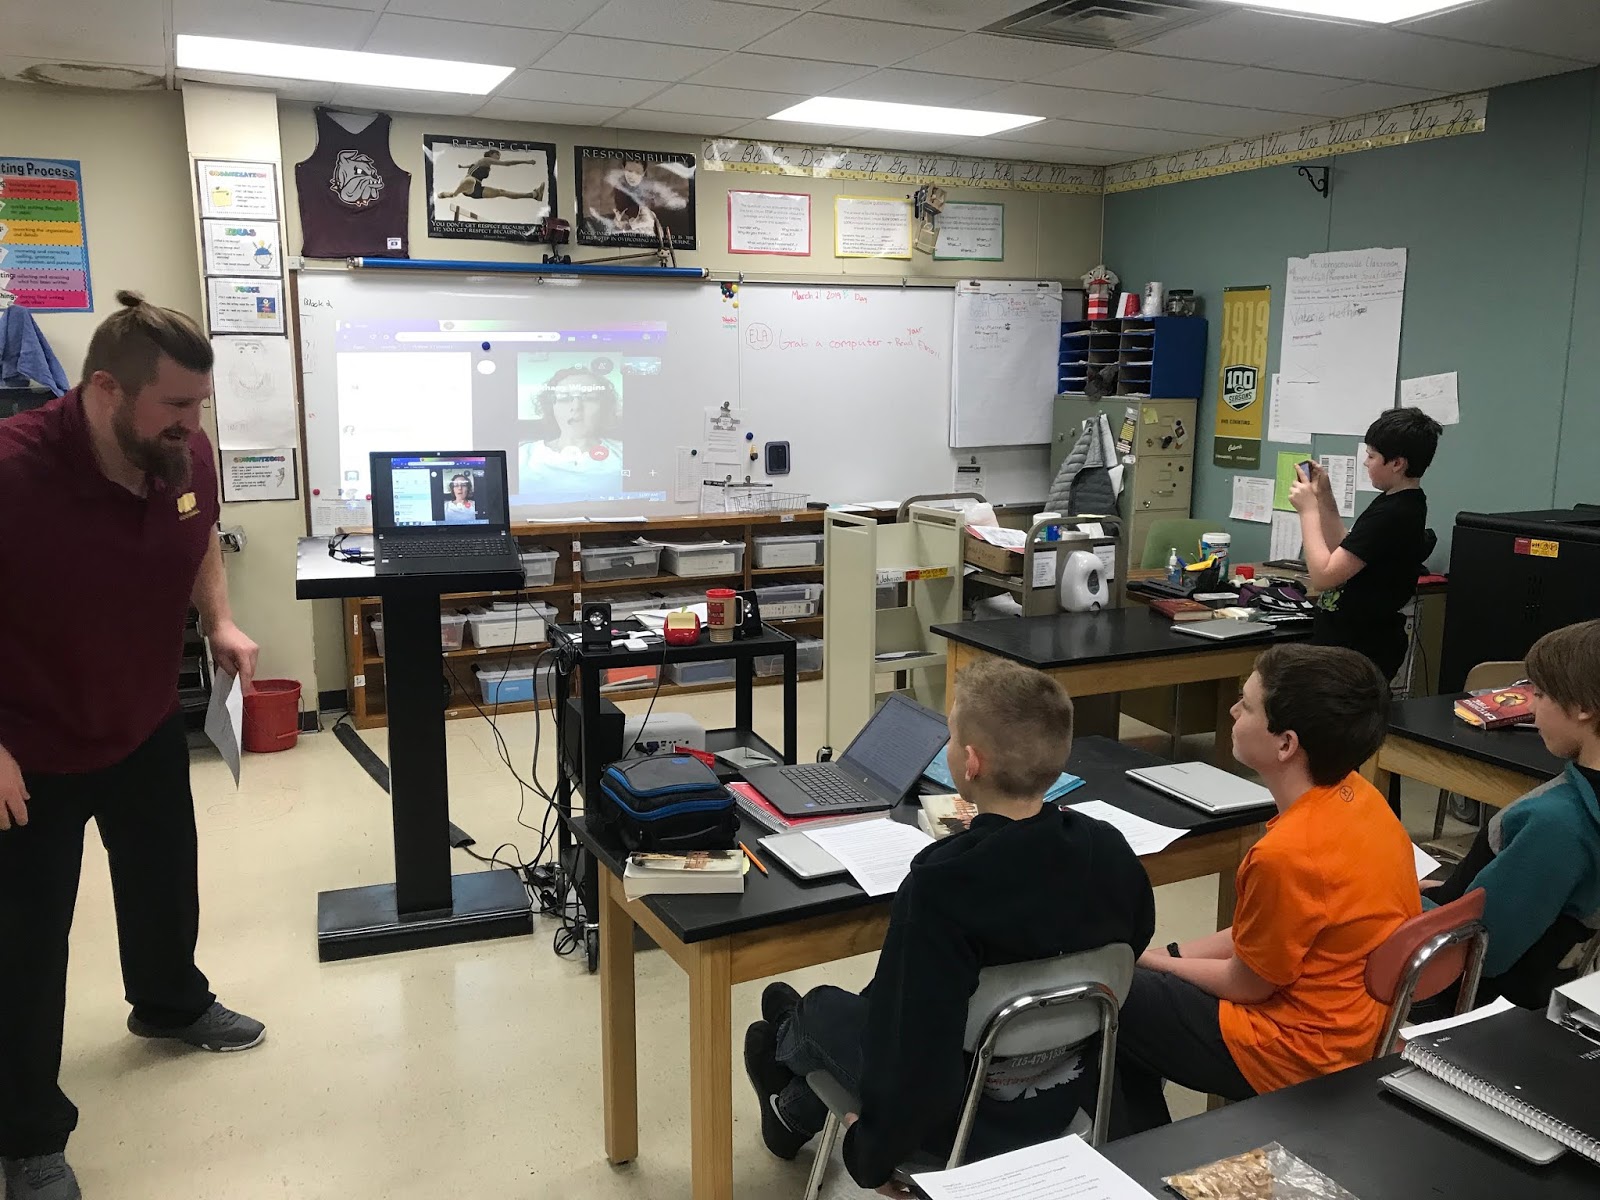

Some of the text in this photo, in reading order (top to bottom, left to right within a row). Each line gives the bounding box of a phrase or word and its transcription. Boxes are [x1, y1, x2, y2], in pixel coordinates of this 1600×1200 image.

[452, 138, 531, 153] RESPECT
[582, 148, 689, 165] RESPONSIBILITY
[26, 162, 75, 178] Process
[431, 220, 446, 228] YOU
[225, 227, 257, 237] IDEAS
[303, 297, 324, 308] Block
[791, 289, 814, 301] March
[854, 292, 868, 304] Day
[1223, 300, 1270, 343] 1919
[749, 328, 768, 344] ELA
[779, 328, 809, 351] Grab
[828, 338, 882, 351] computer
[1227, 370, 1254, 390] 100
[568, 383, 606, 393] Wiggins
[1234, 385, 1245, 394] G
[1228, 391, 1253, 404] SEASONS
[879, 574, 902, 584] Johnson
